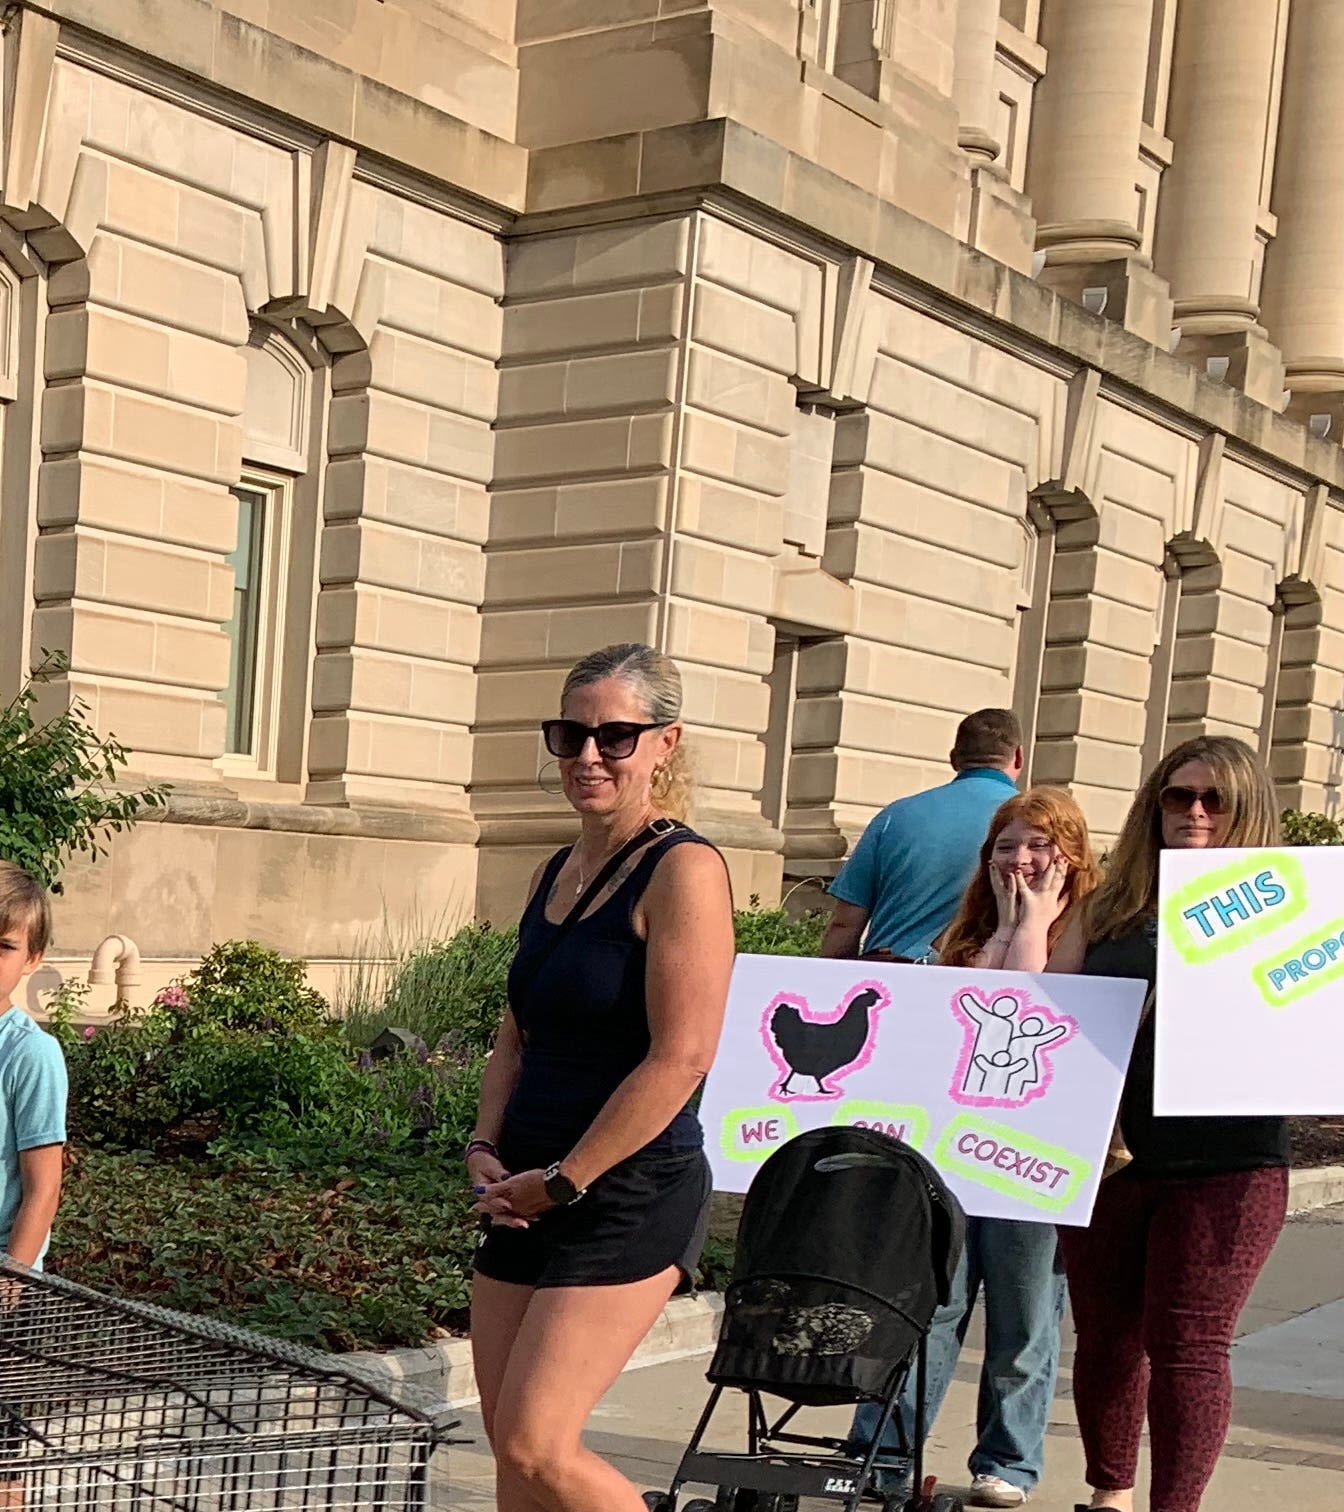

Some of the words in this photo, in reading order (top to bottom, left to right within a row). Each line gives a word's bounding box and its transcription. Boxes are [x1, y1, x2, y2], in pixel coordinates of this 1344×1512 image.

[1183, 870, 1286, 937] THIS
[1267, 931, 1344, 991] PROP
[741, 1119, 780, 1144] WE
[957, 1132, 1070, 1190] COEXIST
